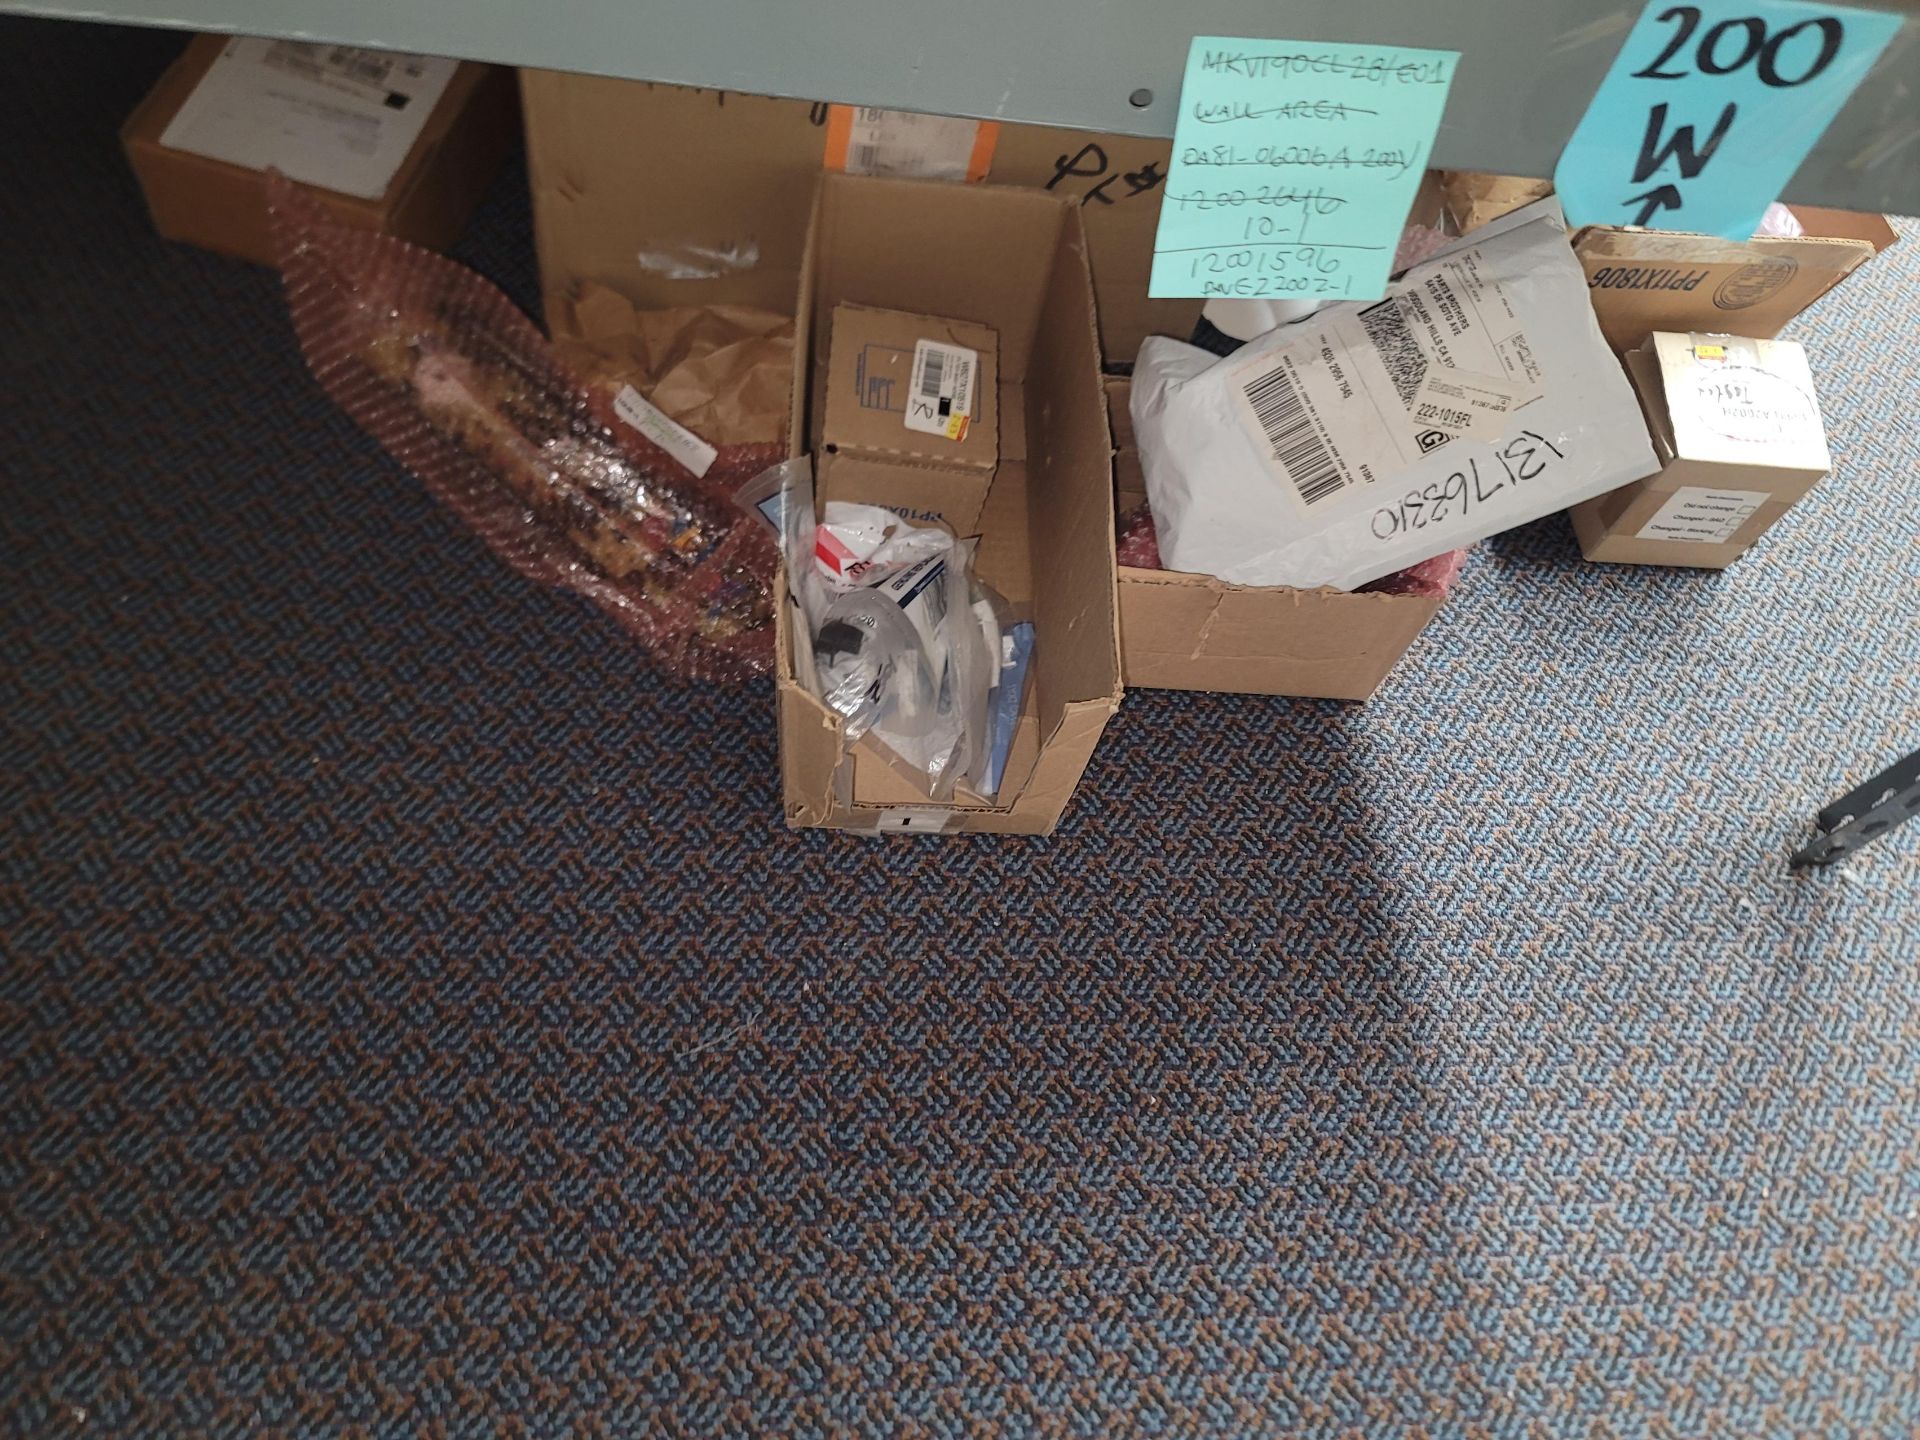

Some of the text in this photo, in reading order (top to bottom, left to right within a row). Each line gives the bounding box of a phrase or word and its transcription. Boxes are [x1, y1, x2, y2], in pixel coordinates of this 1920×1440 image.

[1630, 6, 1844, 88] 200
[1276, 100, 1350, 122] AREA
[1630, 101, 1738, 184] W
[1406, 288, 1432, 325] WOODLAND
[1427, 323, 1443, 346] HILLS
[1439, 302, 1454, 322] SOTO
[1449, 320, 1462, 337] AVE
[1445, 293, 1470, 330] BROTHERS
